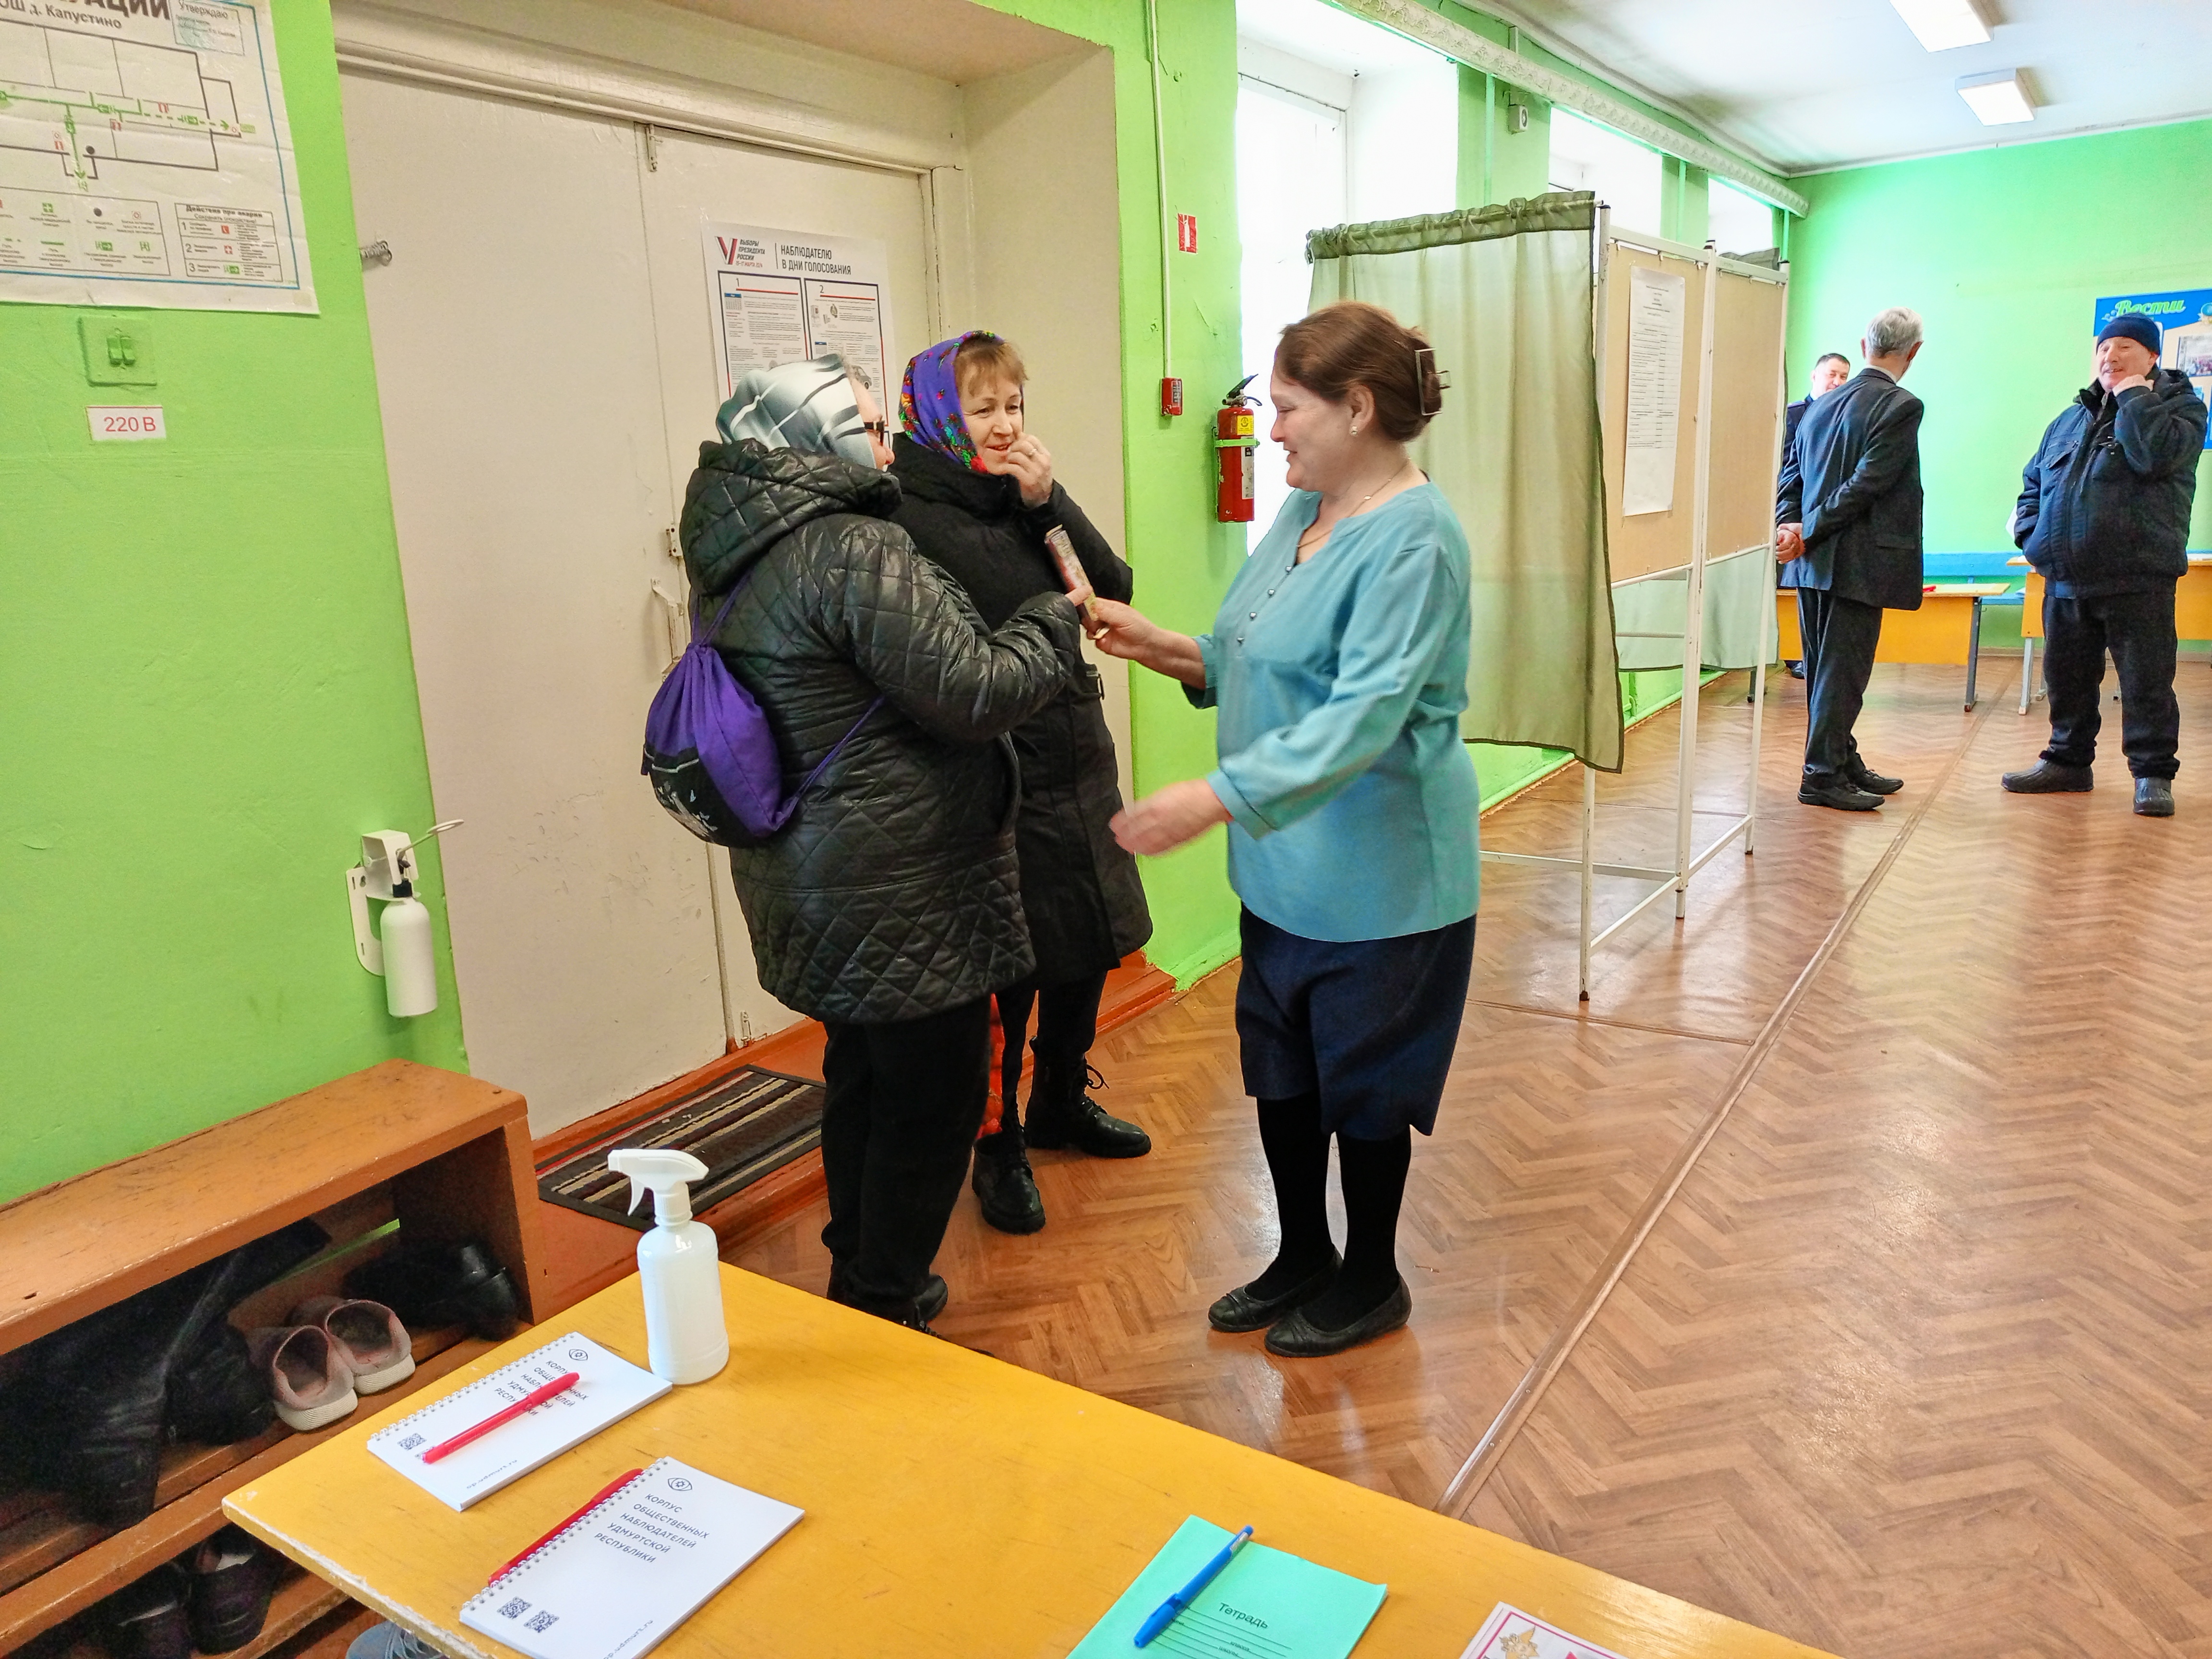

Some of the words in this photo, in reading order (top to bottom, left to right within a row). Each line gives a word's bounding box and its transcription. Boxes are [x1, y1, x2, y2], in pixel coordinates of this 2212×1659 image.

[45, 4, 122, 29] Капустино
[181, 222, 186, 230] 1
[185, 243, 192, 253] 2
[781, 245, 832, 260] НАБЛЮДАТЕЛЮ
[189, 263, 195, 272] 3
[782, 259, 787, 269] В
[789, 260, 803, 271] ДНИ
[805, 261, 851, 275] ГОЛОСОВАНИЯ
[736, 278, 740, 287] 1
[819, 285, 824, 293] 2
[2115, 300, 2186, 317] Вести
[104, 417, 139, 432] 220
[143, 417, 156, 432] В
[546, 1360, 570, 1374] КОРПУ
[507, 1380, 553, 1409] УДМУРОЙ
[520, 1373, 576, 1407] НАБЛЕЛЕЙ
[494, 1387, 539, 1416] РЕСПУКИ
[645, 1493, 682, 1513] КОРПУС
[633, 1503, 710, 1539] ОБЩЕСТВЕННЫХ
[607, 1522, 671, 1553] УДМУРТСКОЙ
[620, 1513, 697, 1548] НАБЛЮДАТЕЛЕЙ
[594, 1533, 657, 1563] РЕСПУБЛИКИ
[1218, 1602, 1269, 1629] Тетрадь
